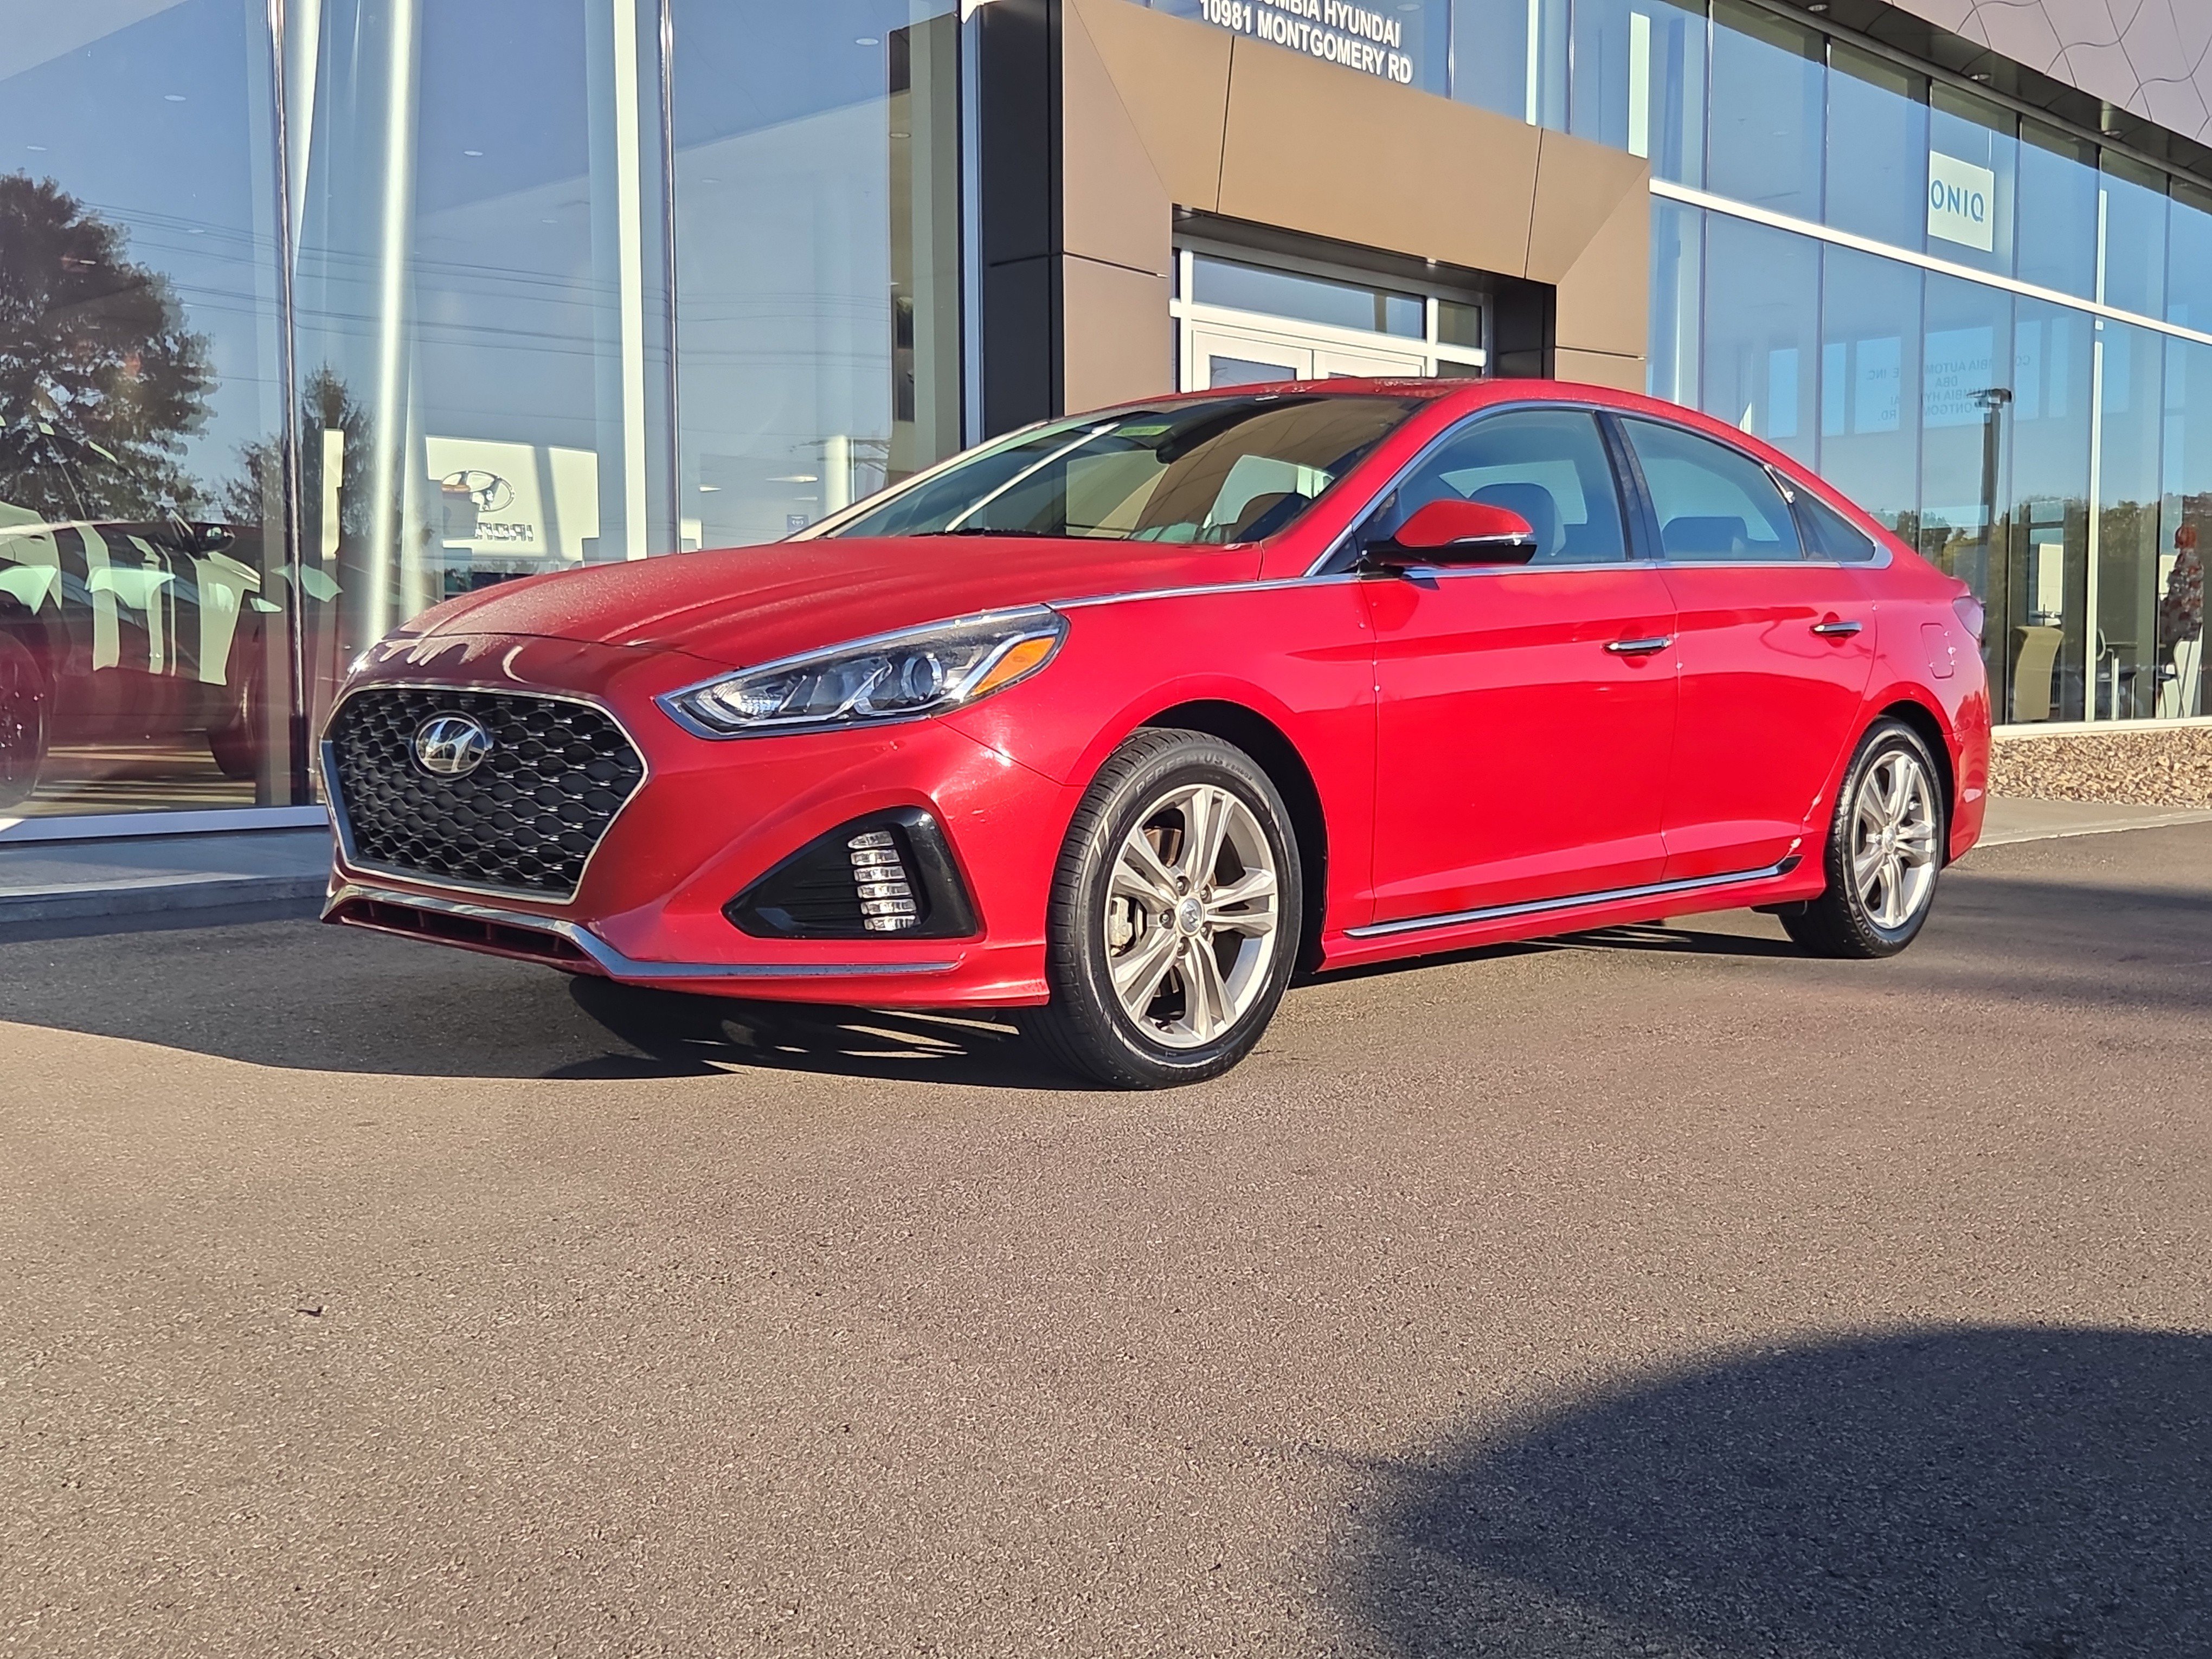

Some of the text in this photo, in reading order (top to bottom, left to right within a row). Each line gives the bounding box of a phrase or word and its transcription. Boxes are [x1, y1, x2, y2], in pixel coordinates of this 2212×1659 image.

[1200, 0, 1413, 83] 10981 MONTGOMERY RD
[1324, 0, 1401, 49] HYUNDAI
